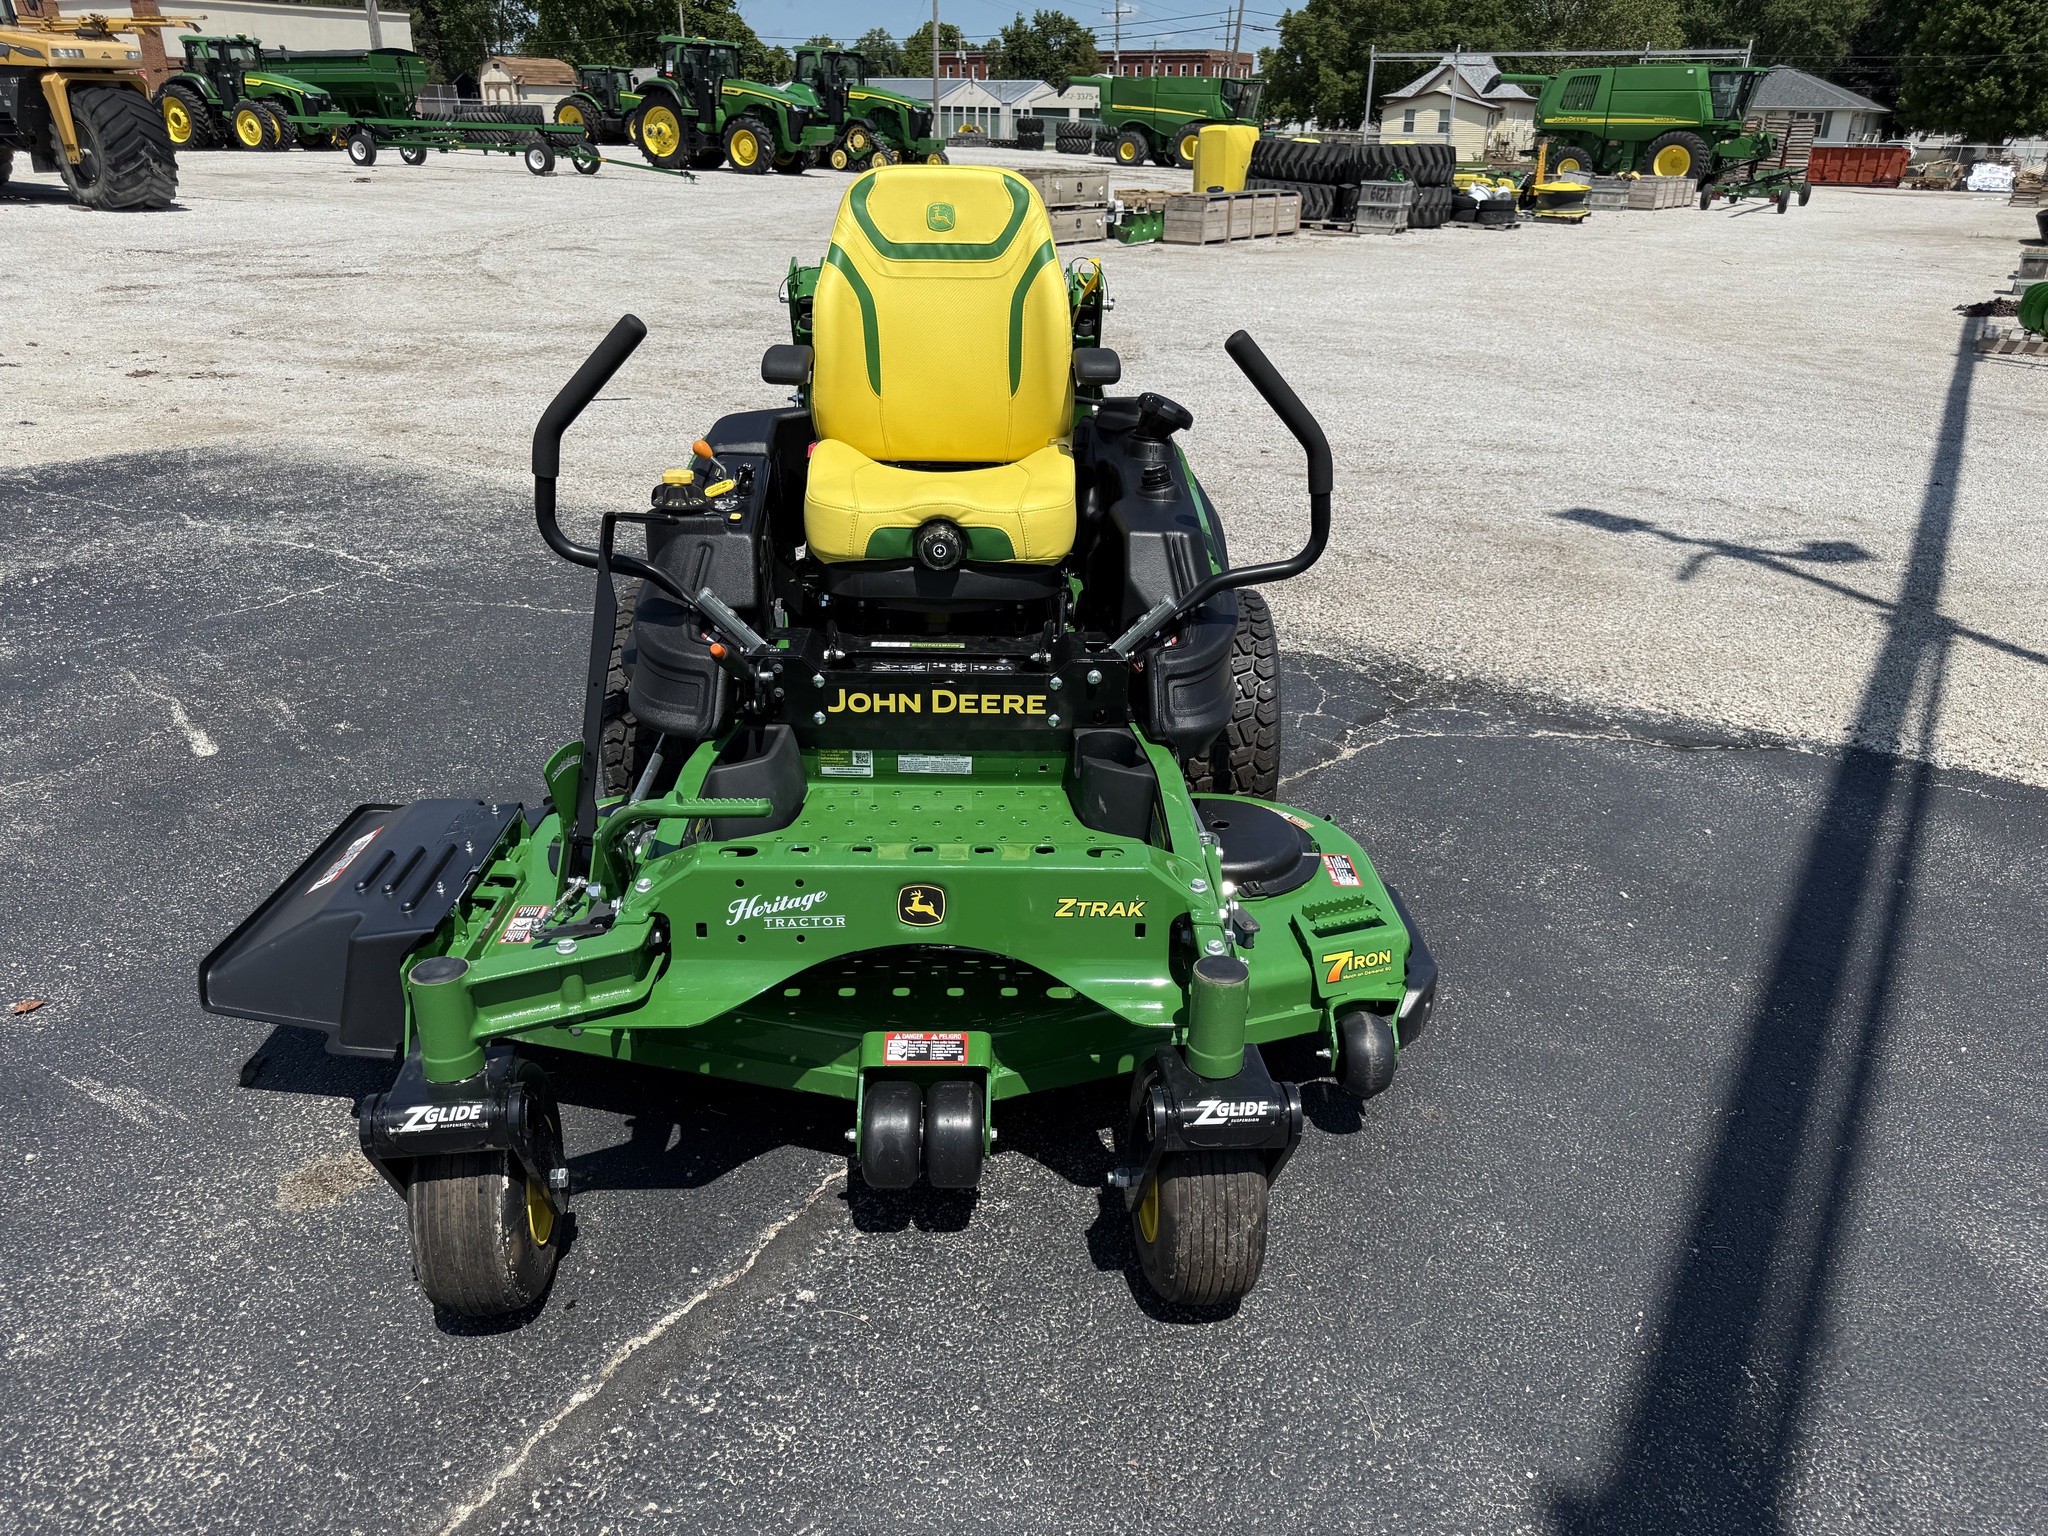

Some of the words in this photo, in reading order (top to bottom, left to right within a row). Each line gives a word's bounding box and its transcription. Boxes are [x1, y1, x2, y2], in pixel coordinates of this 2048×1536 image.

[828, 689, 922, 713] JOHN
[932, 690, 1047, 715] DEERE
[726, 891, 828, 926] Heritage
[1055, 898, 1147, 917] ZTRAK
[764, 917, 846, 928] TRACTOR
[399, 1104, 483, 1133] ZGLIDE
[1193, 1099, 1269, 1126] ZGLIDE
